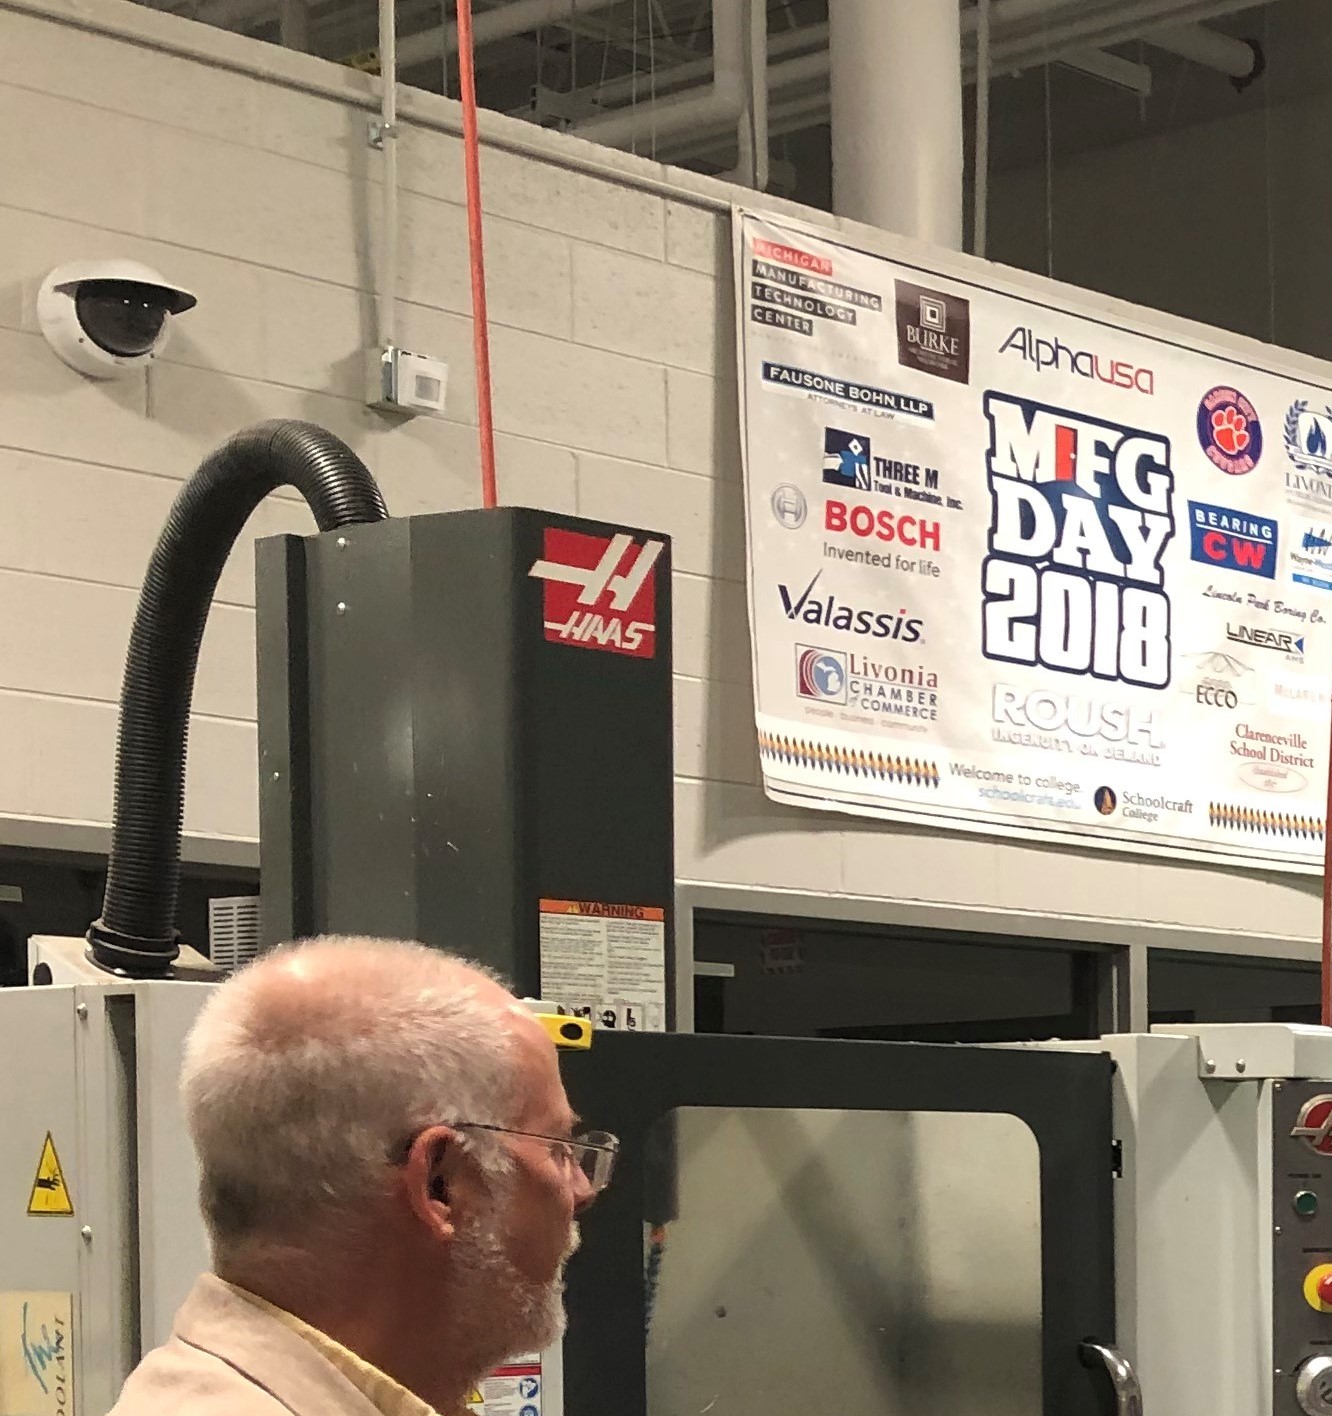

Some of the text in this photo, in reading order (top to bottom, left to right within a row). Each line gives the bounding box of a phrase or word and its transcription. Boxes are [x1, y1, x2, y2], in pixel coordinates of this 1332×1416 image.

[754, 241, 831, 272] MICHIGAN
[755, 264, 880, 309] MANUFACTURING
[754, 286, 854, 322] TECHNOLOGY
[753, 309, 811, 333] CENTER
[906, 325, 960, 355] BURKE
[769, 366, 844, 395] FAUSONE
[900, 398, 929, 414] LLP
[806, 393, 896, 420] ATTORNEYS AT LAW
[986, 395, 1171, 515] MFG
[873, 457, 939, 489] THREE M
[874, 480, 892, 495] Tool
[825, 499, 941, 551] BOSCH
[991, 475, 1171, 585] DAY
[1196, 509, 1272, 539] BEARING
[823, 542, 941, 577] Invented for life
[1202, 533, 1268, 571] CW
[778, 568, 924, 643] Valassis
[1202, 585, 1243, 604] Lincoln
[1273, 600, 1307, 622] Boring
[1310, 609, 1327, 624] Co.
[544, 610, 656, 651] HAAS
[984, 558, 1170, 687] 2018
[1226, 622, 1293, 652] LINEAR
[850, 653, 938, 688] Livonia
[850, 680, 938, 706] CHAMBER
[1195, 684, 1239, 709] ECCO
[861, 698, 938, 720] COMMERCE
[992, 682, 1163, 749] ROUSH
[1235, 723, 1308, 750] Clarenceville
[1230, 740, 1315, 769] School District
[949, 762, 1014, 784] Welcome
[1018, 773, 1032, 786] to
[1122, 806, 1160, 822] College
[1123, 790, 1194, 813] Schoolcraft
[577, 902, 645, 921] WARNING
